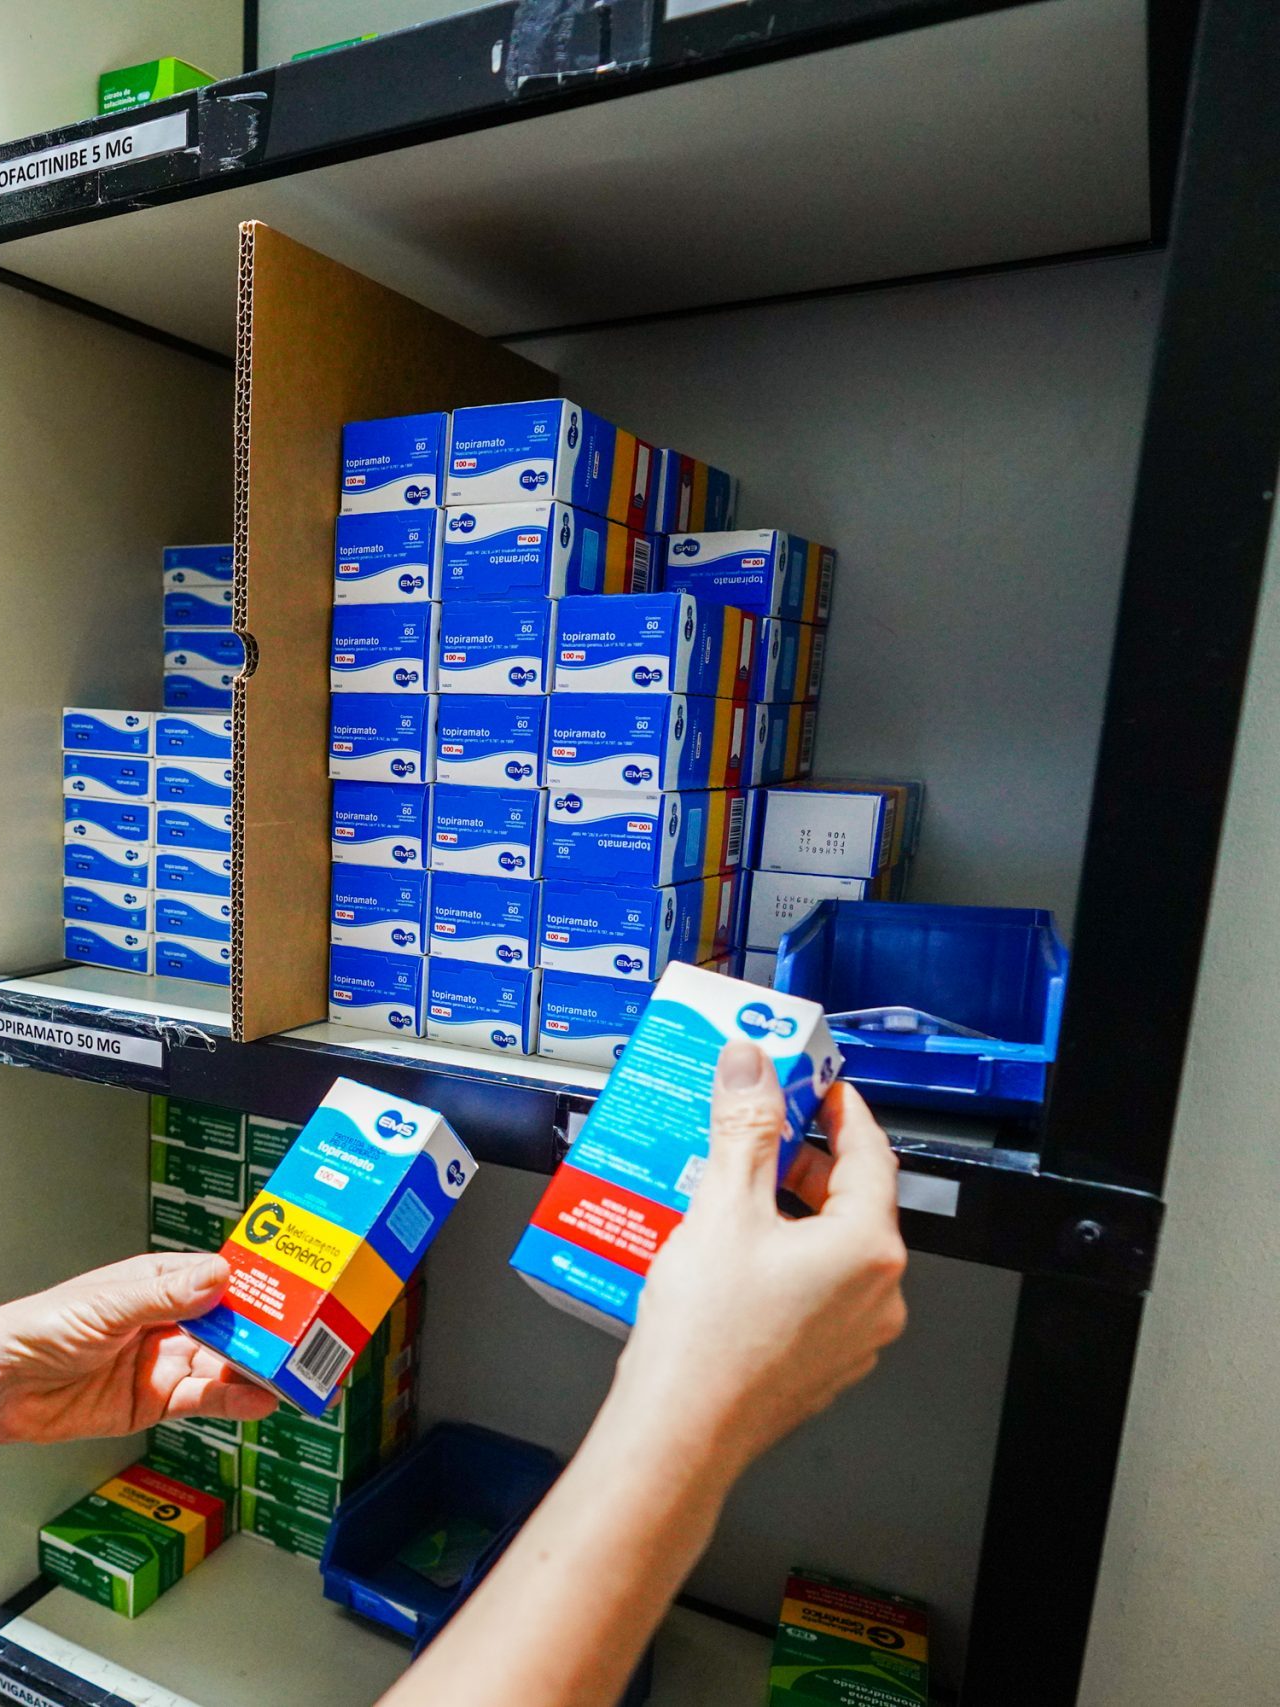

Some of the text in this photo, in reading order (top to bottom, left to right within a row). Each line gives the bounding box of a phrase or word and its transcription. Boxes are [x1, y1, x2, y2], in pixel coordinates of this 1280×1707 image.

[93, 145, 100, 163] 5
[106, 136, 132, 159] MG
[534, 425, 545, 433] 60
[416, 443, 425, 451] 60
[456, 439, 505, 450] topiramato
[346, 456, 390, 468] topiramato
[340, 545, 384, 555] topiramato
[490, 555, 539, 564] topiramato
[453, 567, 463, 575] 60
[714, 576, 762, 584] topiramato
[445, 635, 493, 644] topiramato
[562, 632, 616, 641] topiramato
[336, 637, 379, 647] topiramato
[636, 721, 648, 729] 60
[334, 726, 377, 735] topiramato
[443, 727, 490, 737] topiramato
[554, 729, 606, 738] topiramato
[557, 800, 580, 808] EMS
[336, 811, 378, 821] topiramato
[437, 816, 483, 827] topiramato
[598, 839, 650, 850] topiramato
[559, 846, 569, 854] 60
[336, 894, 377, 906] topiramato
[436, 907, 481, 919] topiramato
[508, 906, 518, 914] 60
[547, 914, 598, 927] topiramato
[628, 914, 639, 922] 60
[499, 950, 520, 958] EMS
[617, 960, 640, 969] EMS
[334, 975, 375, 987] topiramato
[432, 990, 476, 1004] topiramato
[503, 992, 512, 1000] 60
[547, 1003, 597, 1017] topiramato
[626, 1005, 637, 1013] 60
[391, 1016, 410, 1024] EMS
[740, 1008, 794, 1036] EMS
[77, 1034, 92, 1048] 50
[97, 1038, 120, 1054] MG
[378, 1116, 415, 1137] EMS
[318, 1141, 375, 1172] topiramato
[245, 1202, 285, 1244] G
[287, 1223, 341, 1257] Medicamento
[276, 1235, 332, 1274] Genérico
